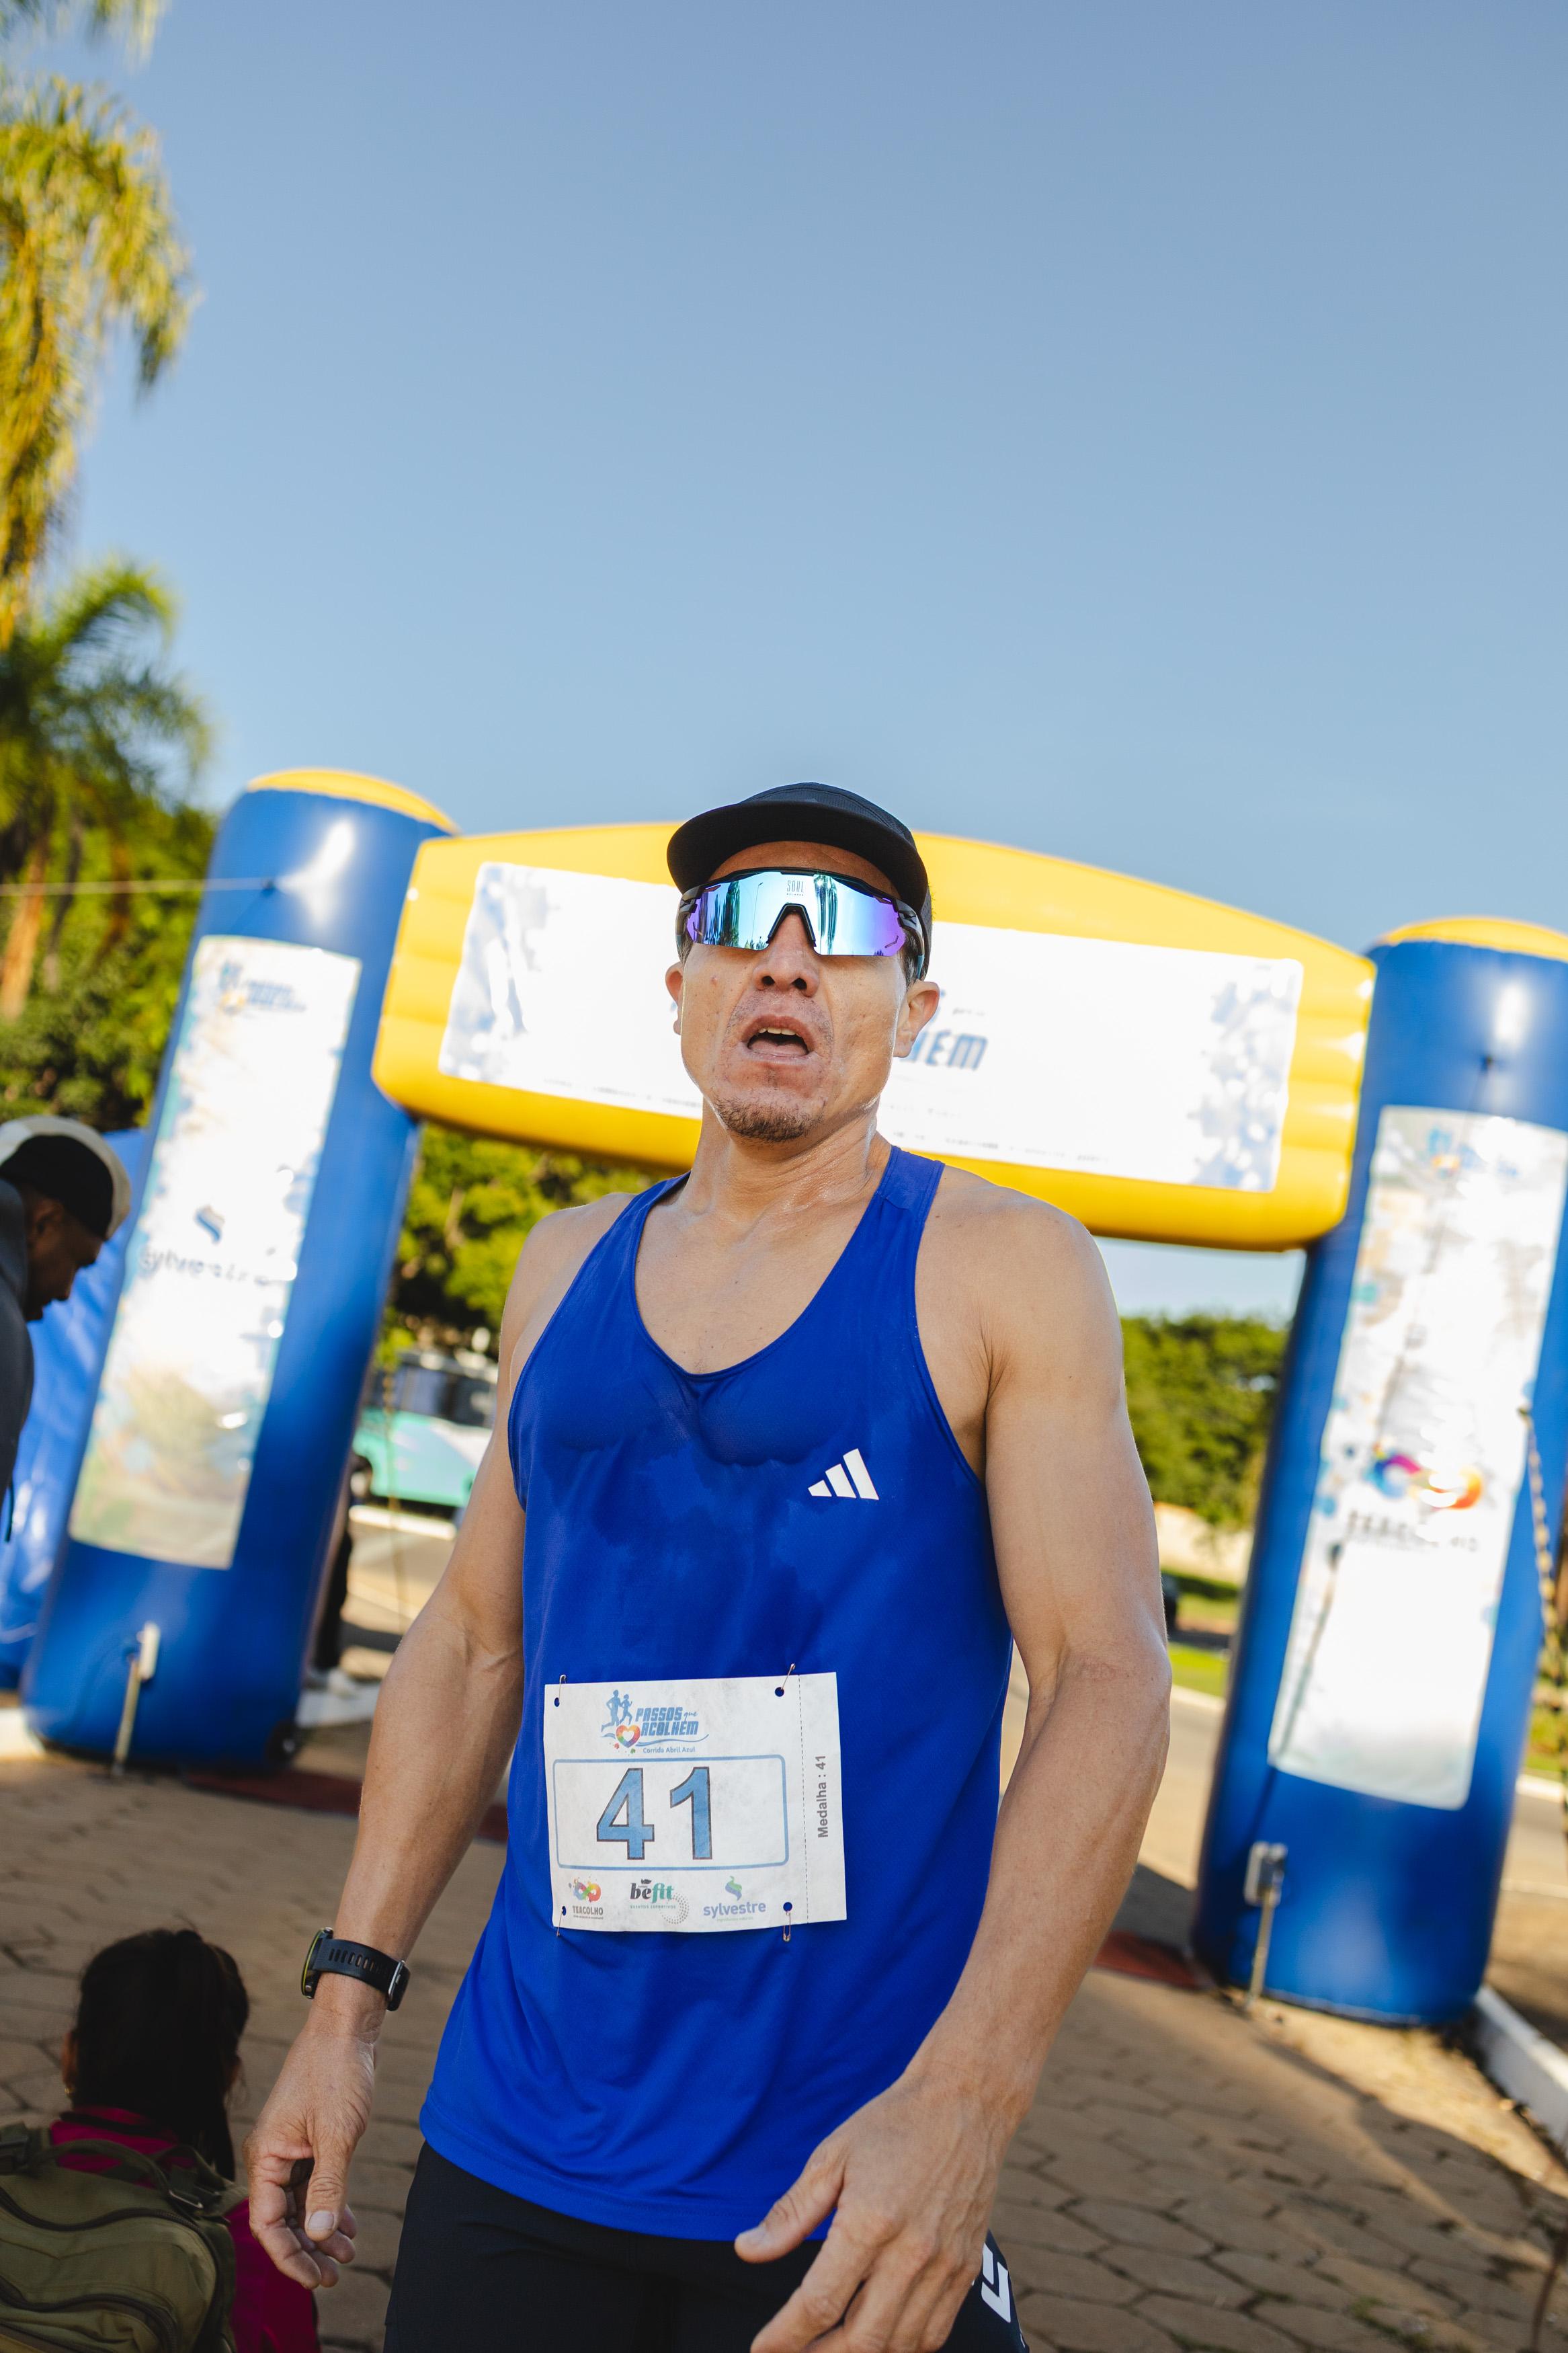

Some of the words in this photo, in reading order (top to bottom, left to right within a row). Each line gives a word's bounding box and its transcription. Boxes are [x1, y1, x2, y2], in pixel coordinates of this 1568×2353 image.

[635, 1707, 684, 1722] PASSOS
[684, 1710, 698, 1722] que
[641, 1720, 699, 1737] ACOLHEM
[815, 1755, 826, 1770] 41
[596, 1766, 712, 1860] 41
[817, 1782, 829, 1838] Medalha
[630, 1882, 674, 1904] befit
[572, 1905, 604, 1916] TEACOLHO
[703, 1901, 767, 1919] sylvestre
